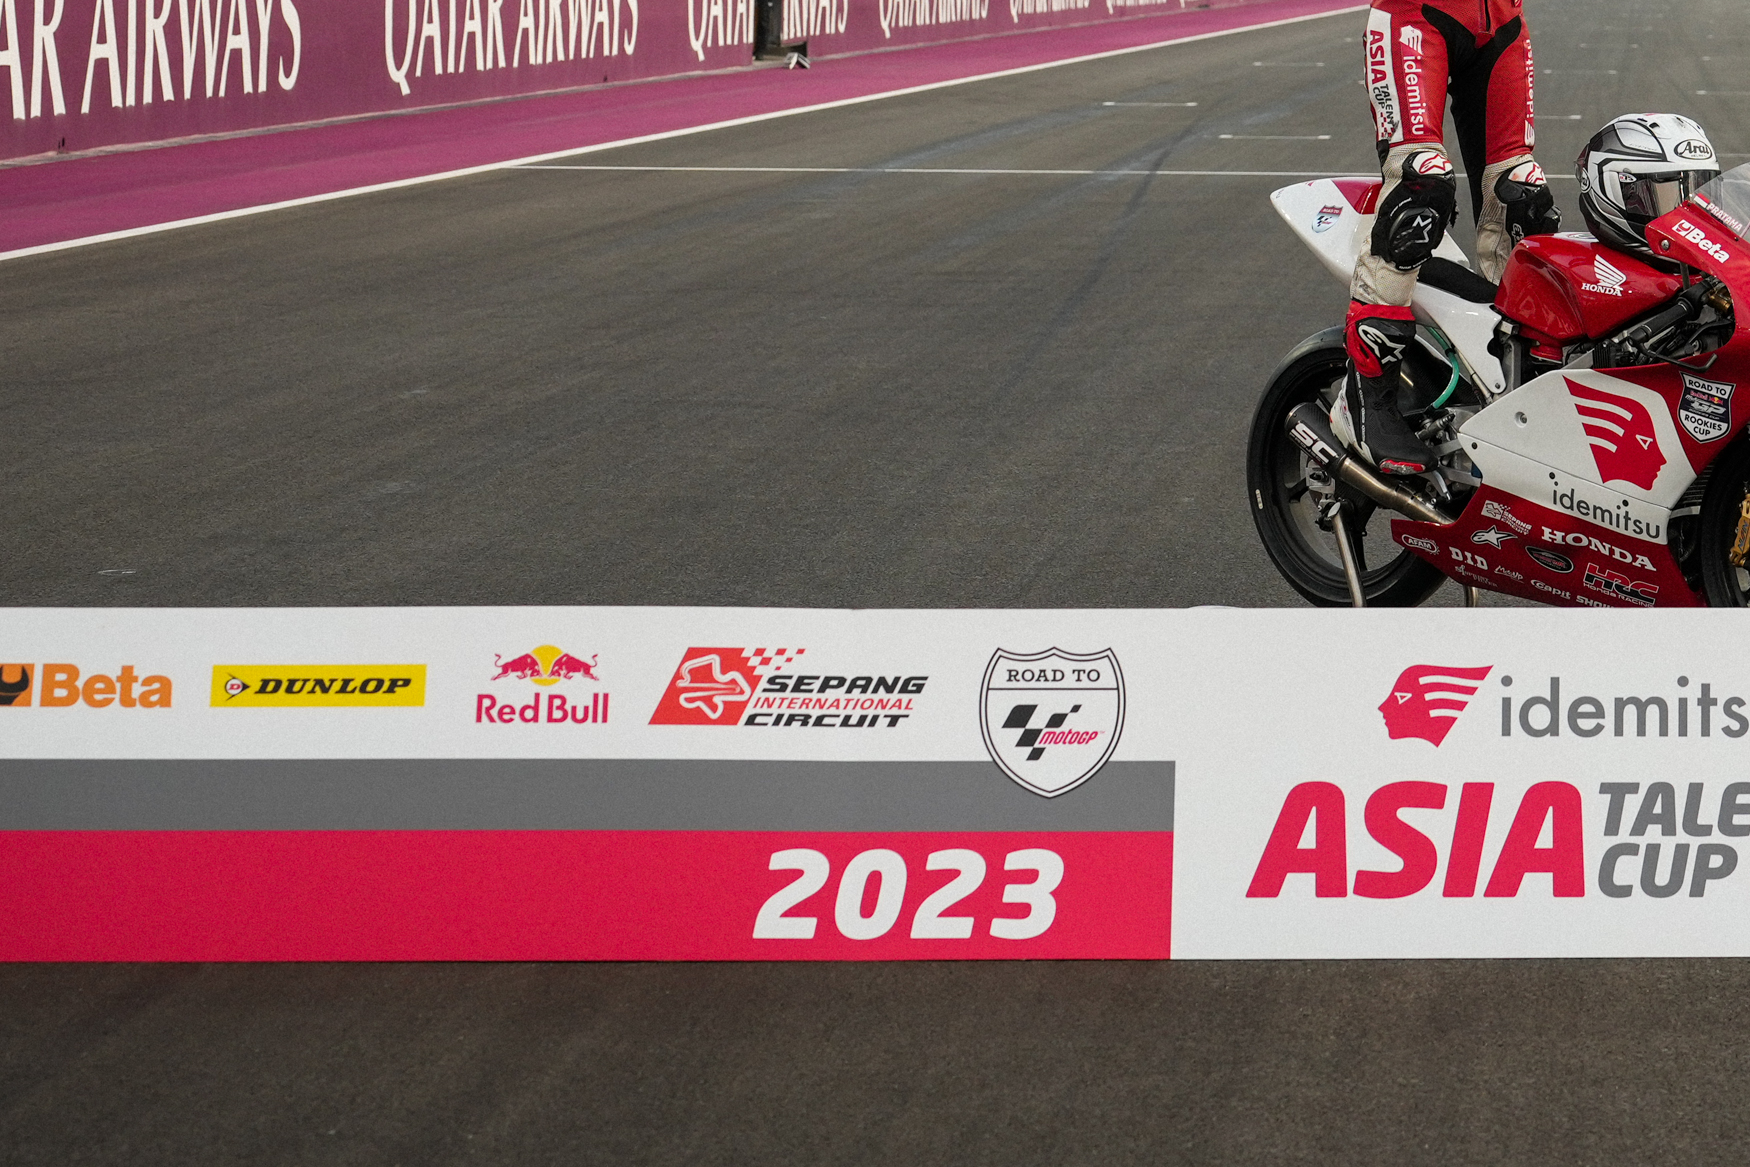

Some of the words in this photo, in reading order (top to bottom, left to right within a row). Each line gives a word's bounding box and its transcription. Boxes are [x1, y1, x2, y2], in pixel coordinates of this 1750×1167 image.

[1370, 29, 1387, 85] ASIA
[1373, 86, 1385, 109] CUP
[1403, 55, 1427, 135] idemitsu
[1706, 203, 1743, 232] PRATAMA
[1685, 227, 1730, 264] Beta
[1581, 282, 1622, 296] HONDA
[1688, 379, 1713, 392] ROAD
[1715, 386, 1727, 396] TO
[1684, 413, 1723, 432] ROOKIES
[1693, 426, 1711, 436] CUP
[1553, 481, 1660, 539] idemitsu
[1408, 538, 1432, 550] AFAM
[1541, 526, 1657, 571] HONDA
[1583, 563, 1659, 605] HRC
[1583, 582, 1617, 598] Honda
[40, 663, 173, 708] Beta
[254, 677, 412, 695] DUNLOP
[762, 674, 929, 694] SEPANG
[1006, 669, 1065, 683] ROAD
[1072, 669, 1101, 683] TO
[475, 692, 539, 724] Red
[547, 692, 609, 724] Bull
[753, 697, 914, 711] INTERNATIONAL
[744, 713, 910, 728] CIRCUIT
[1245, 780, 1586, 899] ASIA
[1598, 842, 1739, 898] CUP
[752, 848, 1065, 940] 2023
